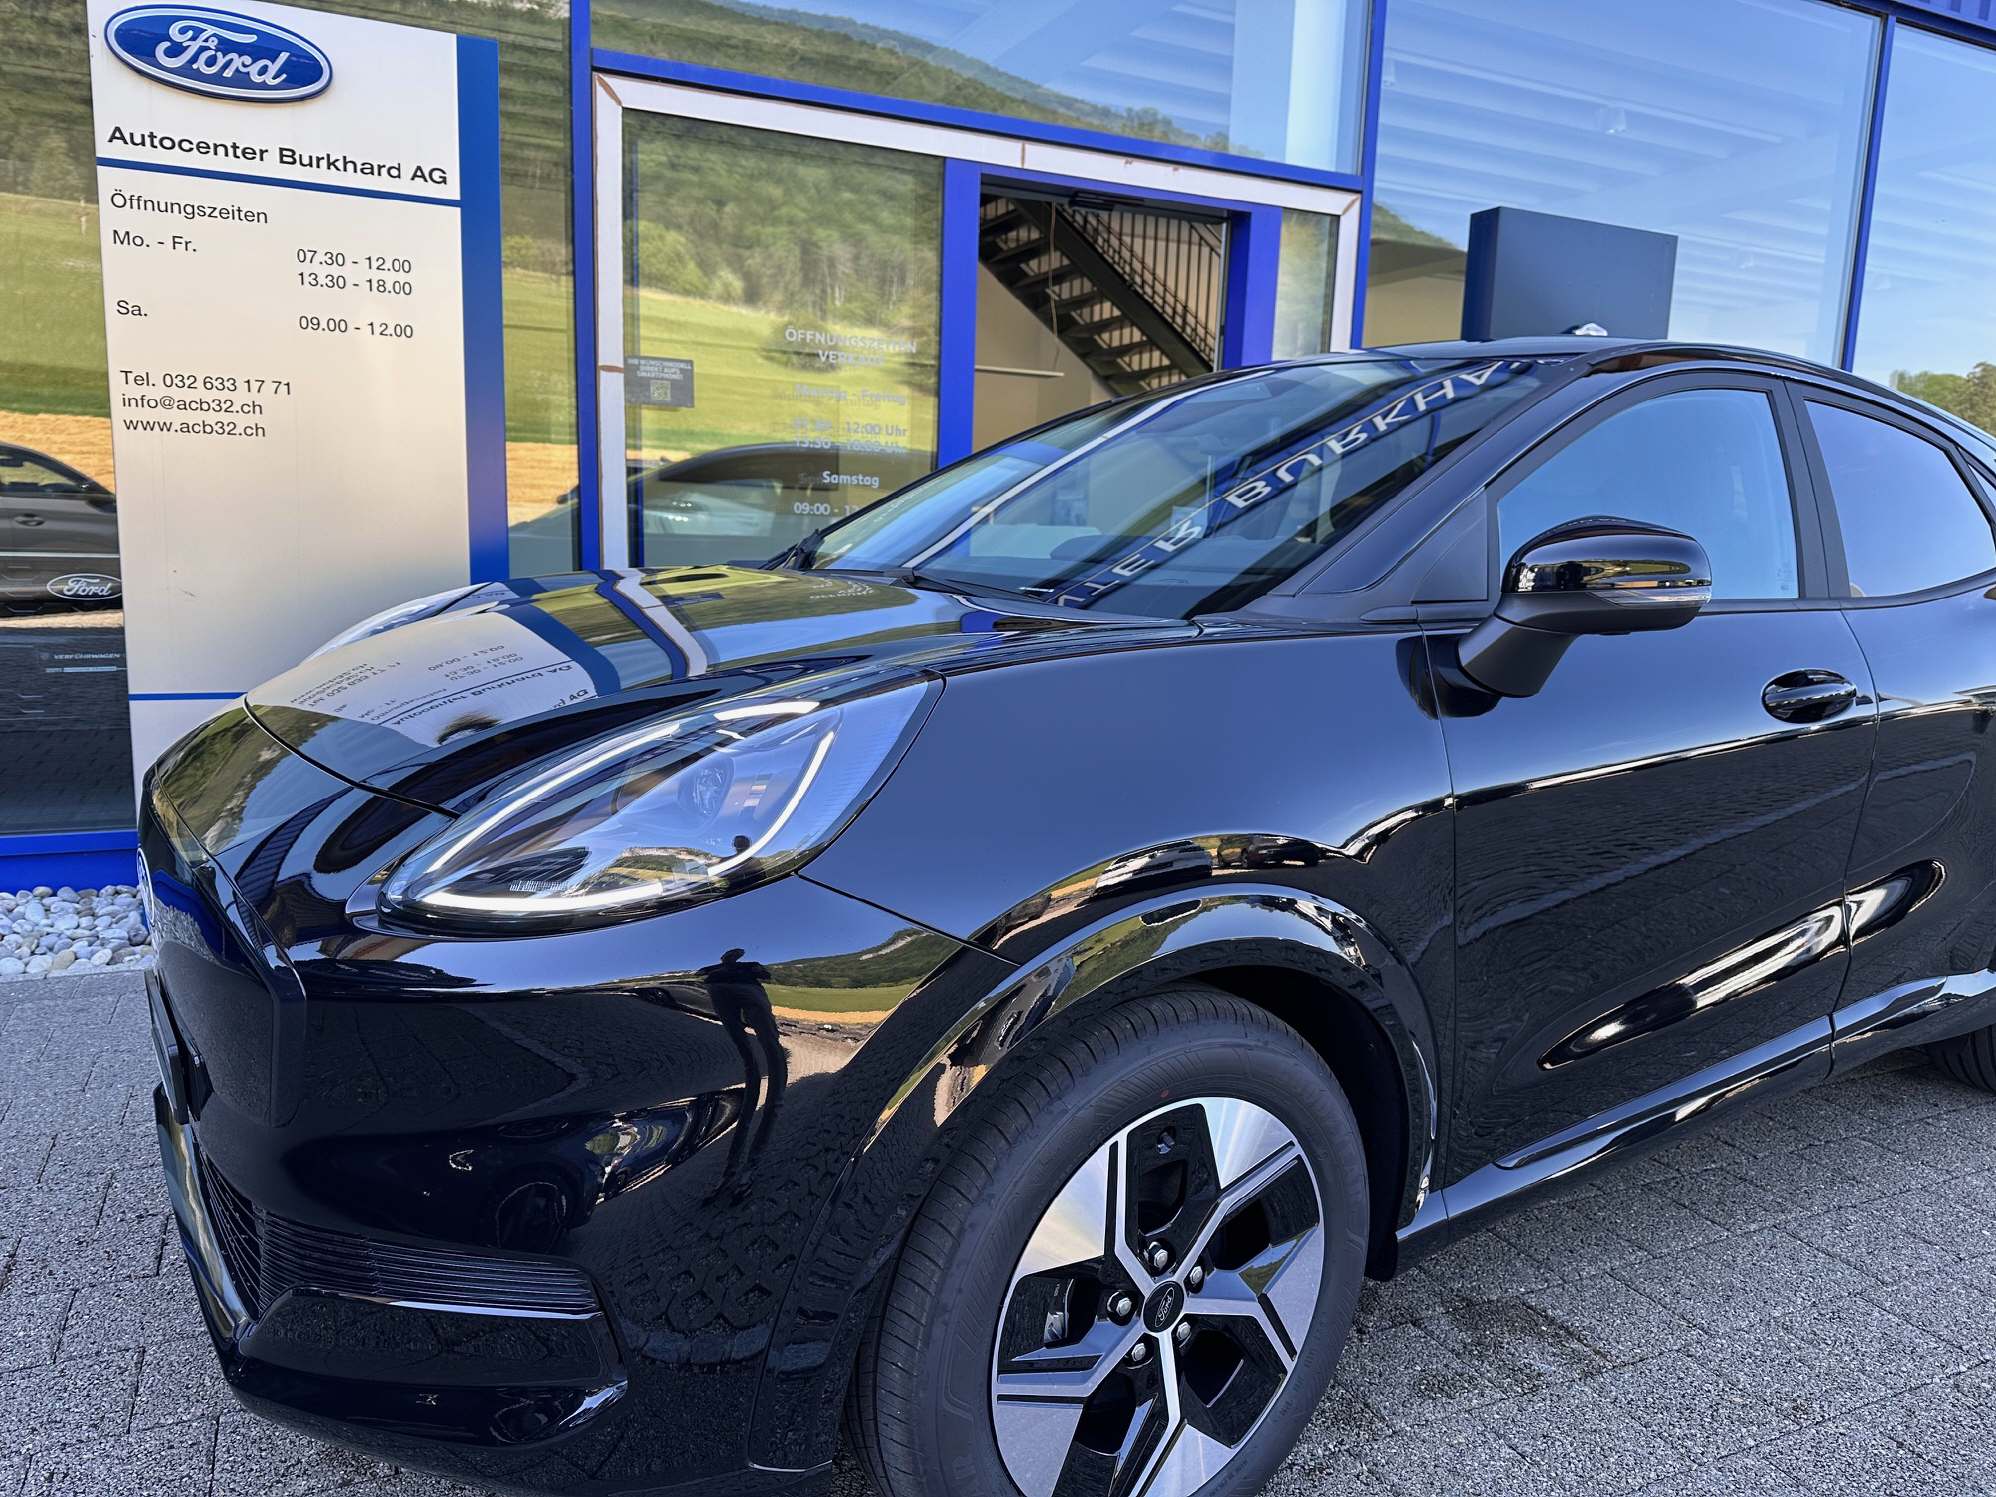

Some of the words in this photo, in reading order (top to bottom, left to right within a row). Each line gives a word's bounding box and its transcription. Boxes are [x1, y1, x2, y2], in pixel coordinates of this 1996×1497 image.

[155, 20, 291, 86] Ford
[107, 126, 269, 163] Autocenter
[278, 146, 402, 180] Burkhard
[410, 164, 448, 185] AG
[110, 189, 269, 224] Öffnungszeiten
[112, 229, 151, 249] Mo.
[171, 235, 198, 253] Fr.
[296, 248, 346, 268] 07.30
[364, 255, 412, 274] 12.00
[297, 272, 347, 290] 13.30
[365, 278, 413, 296] 18.00
[116, 299, 149, 318] Sa.
[298, 316, 348, 334] 09.00
[367, 321, 414, 339] 12.00
[120, 369, 156, 388] Tel.
[162, 372, 198, 390] 032
[203, 375, 238, 392] 633
[243, 377, 266, 394] 17
[271, 379, 292, 396] 71
[121, 393, 263, 416] info@acb32.ch
[123, 417, 267, 439] www.acb32.ch
[821, 470, 881, 488] Samstag
[793, 501, 831, 515] 09:00
[63, 577, 112, 596] Ford
[1158, 1296, 1172, 1321] Ford
